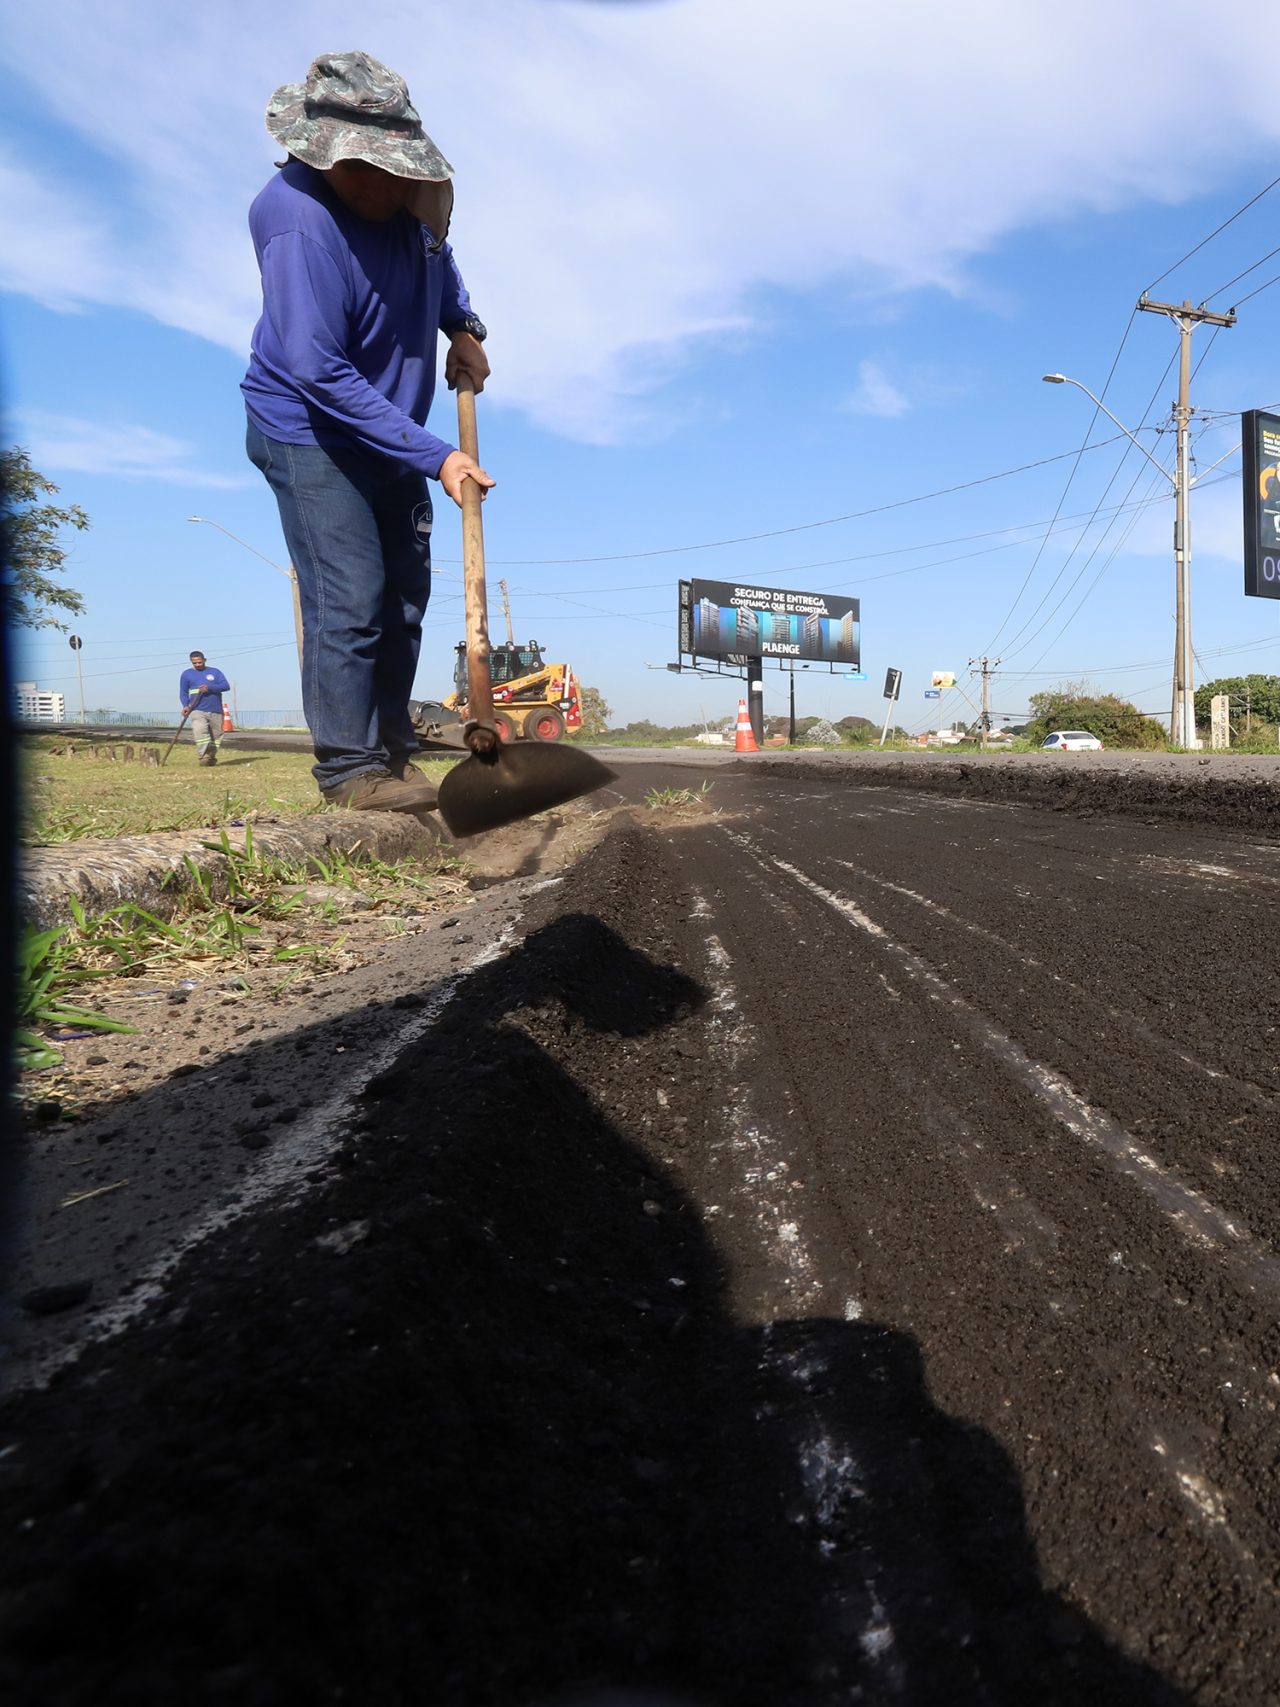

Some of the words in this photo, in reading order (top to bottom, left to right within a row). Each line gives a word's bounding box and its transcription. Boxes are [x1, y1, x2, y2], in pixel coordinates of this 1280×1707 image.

[730, 597, 770, 611] CONFIANÇA
[771, 602, 786, 612] QUE
[786, 603, 796, 612] SE
[734, 587, 772, 600] SEGURO
[774, 591, 786, 602] DE
[786, 593, 825, 607] ENTREGA
[762, 641, 800, 655] PLAENGE
